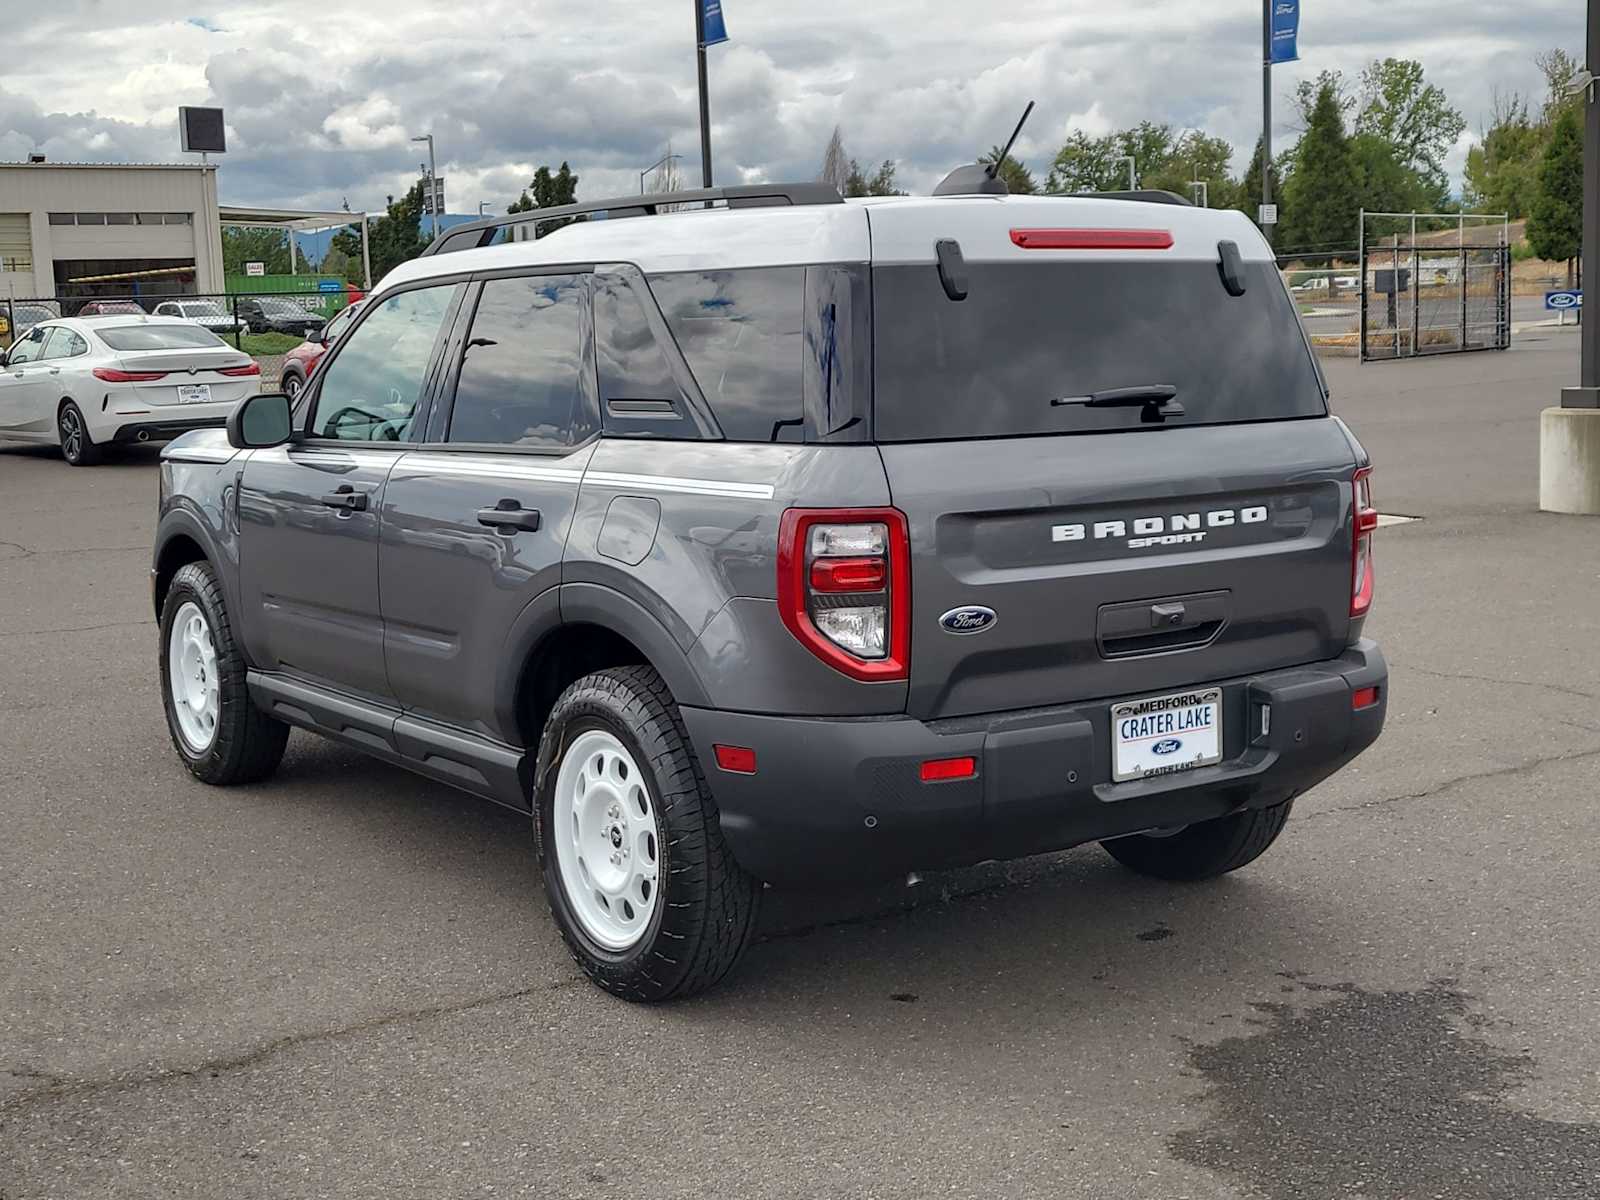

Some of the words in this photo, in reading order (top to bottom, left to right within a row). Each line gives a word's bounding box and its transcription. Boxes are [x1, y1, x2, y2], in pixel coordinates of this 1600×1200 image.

[1052, 506, 1268, 542] BRONCO
[1128, 532, 1207, 549] SPORT
[1139, 695, 1196, 714] MEDFORD
[1121, 713, 1174, 739] CRATER
[1178, 706, 1211, 730] LAKE
